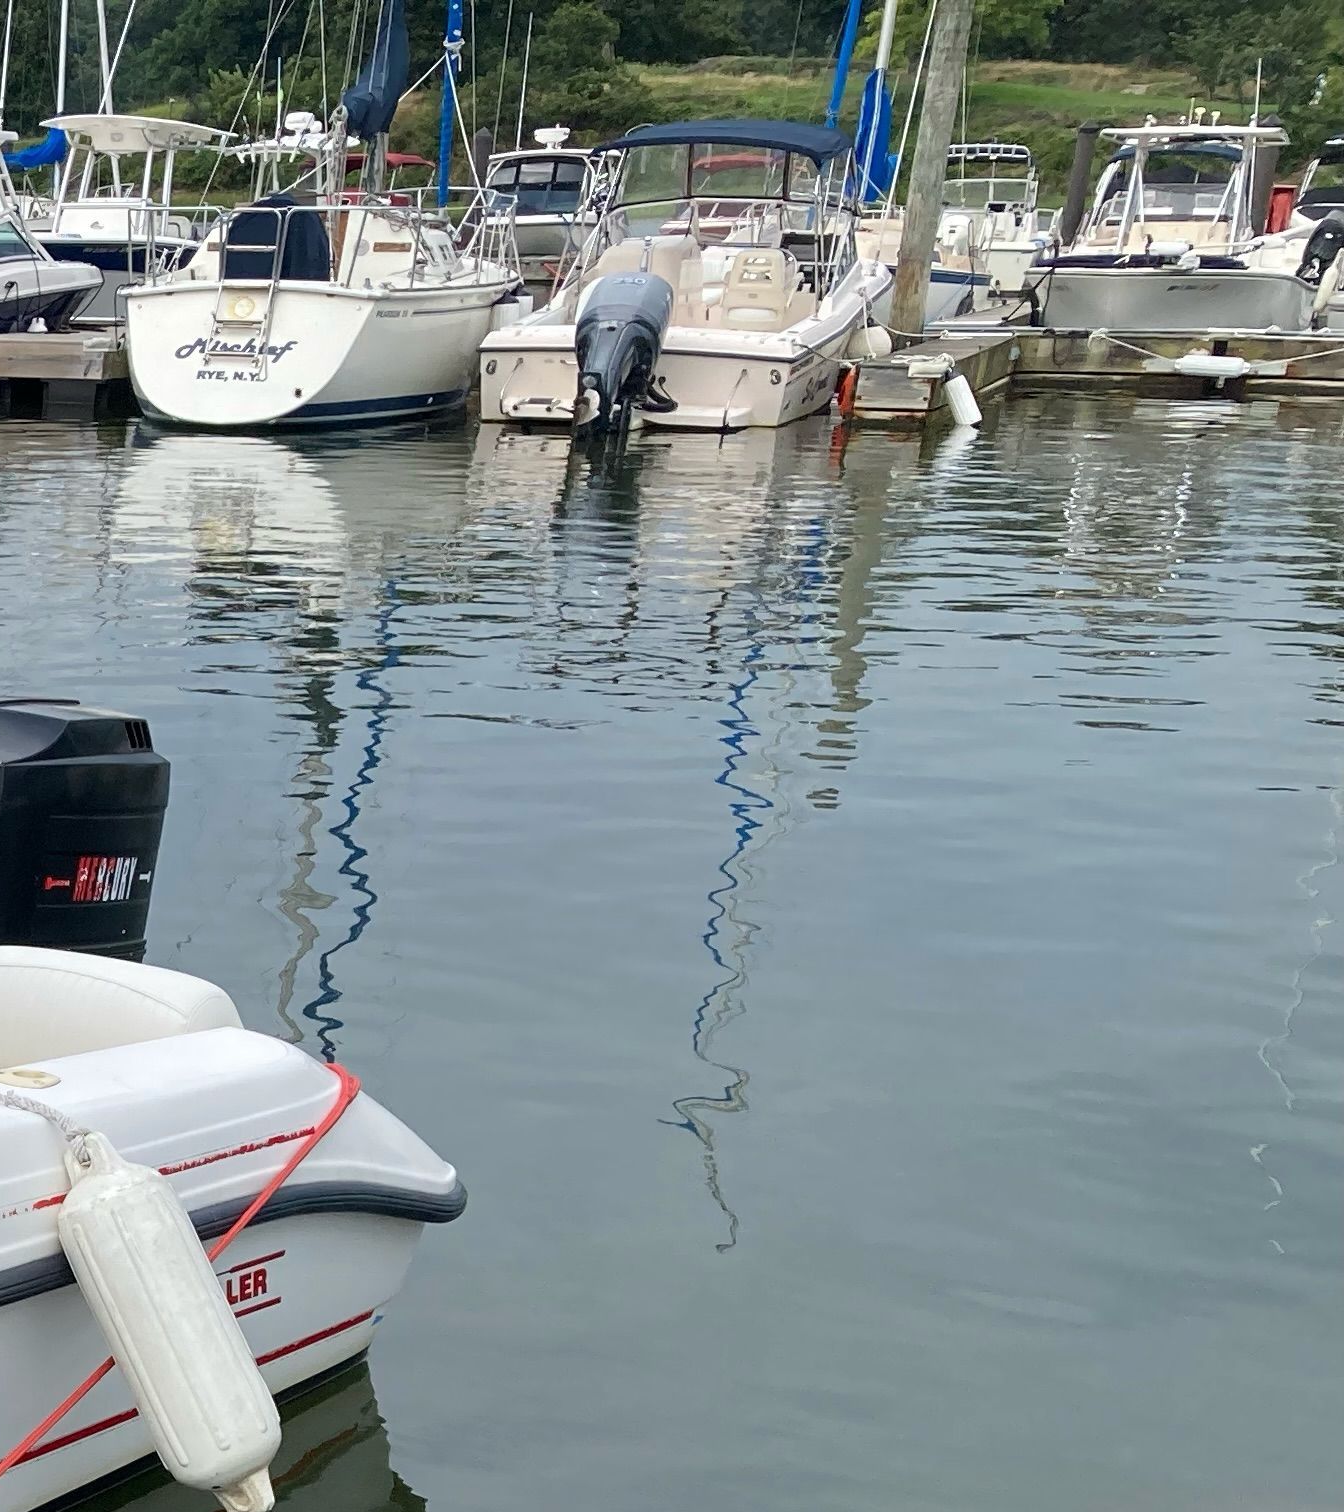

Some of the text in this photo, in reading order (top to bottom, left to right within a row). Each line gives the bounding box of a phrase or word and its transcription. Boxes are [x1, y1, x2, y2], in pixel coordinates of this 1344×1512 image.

[175, 337, 298, 363] Mischief
[196, 370, 228, 381] RYE,
[73, 857, 138, 901] MERCURY
